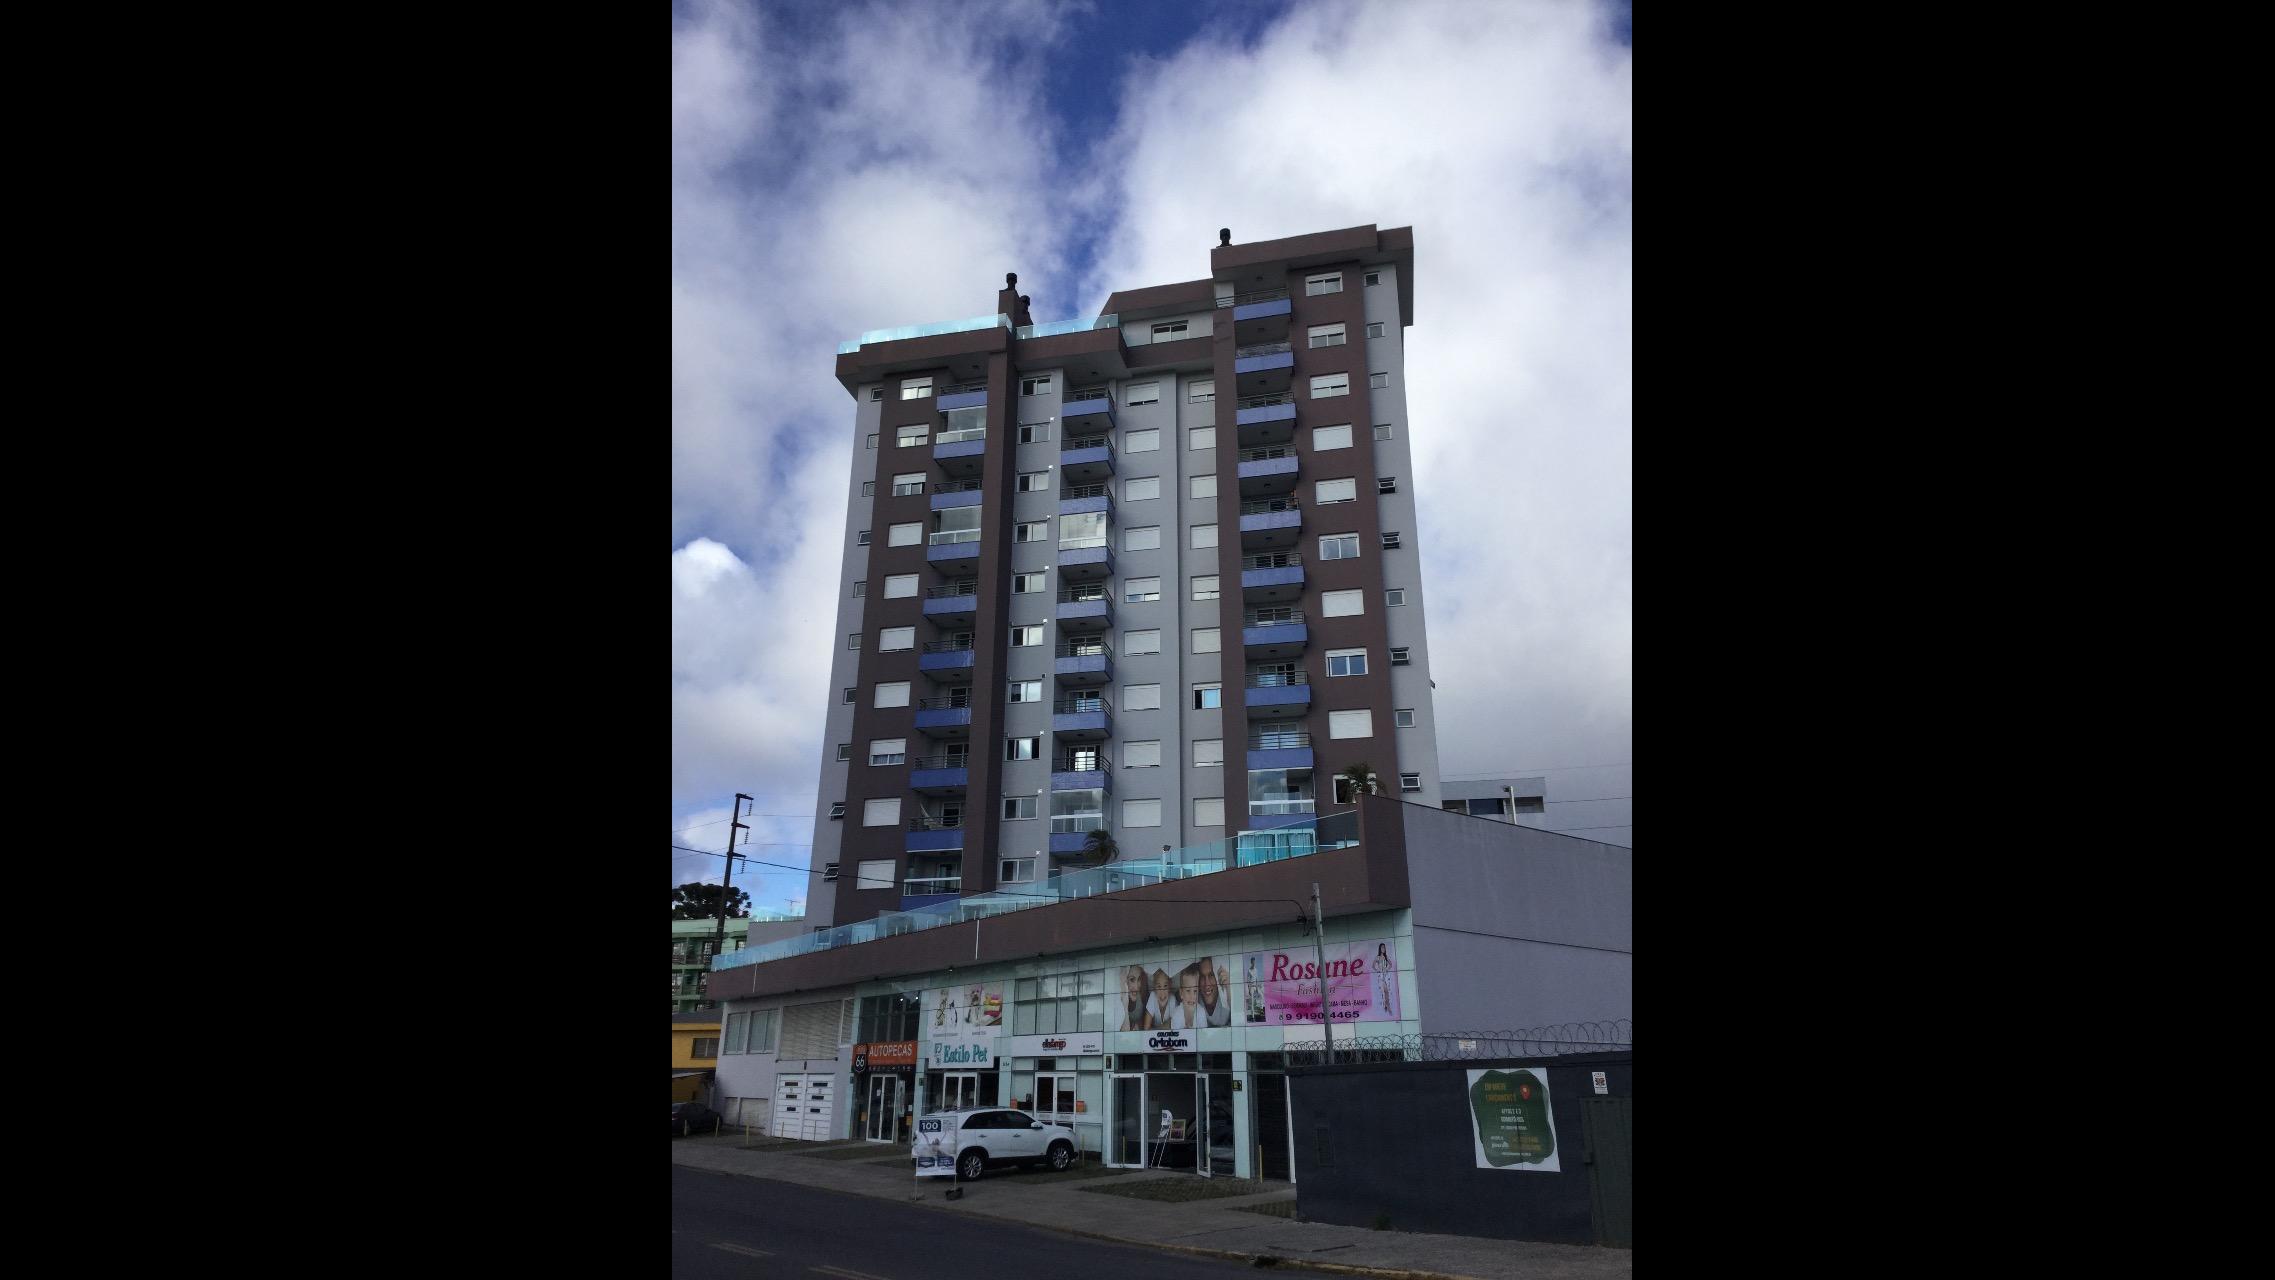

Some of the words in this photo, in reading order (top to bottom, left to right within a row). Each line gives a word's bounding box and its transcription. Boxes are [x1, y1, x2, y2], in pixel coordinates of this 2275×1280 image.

[1270, 954, 1364, 982] Rosane
[1297, 984, 1336, 995] Fashn
[943, 1044, 971, 1063] Estilo
[972, 1044, 988, 1063] Pet
[855, 1055, 865, 1067] 66
[921, 1122, 939, 1130] 100
